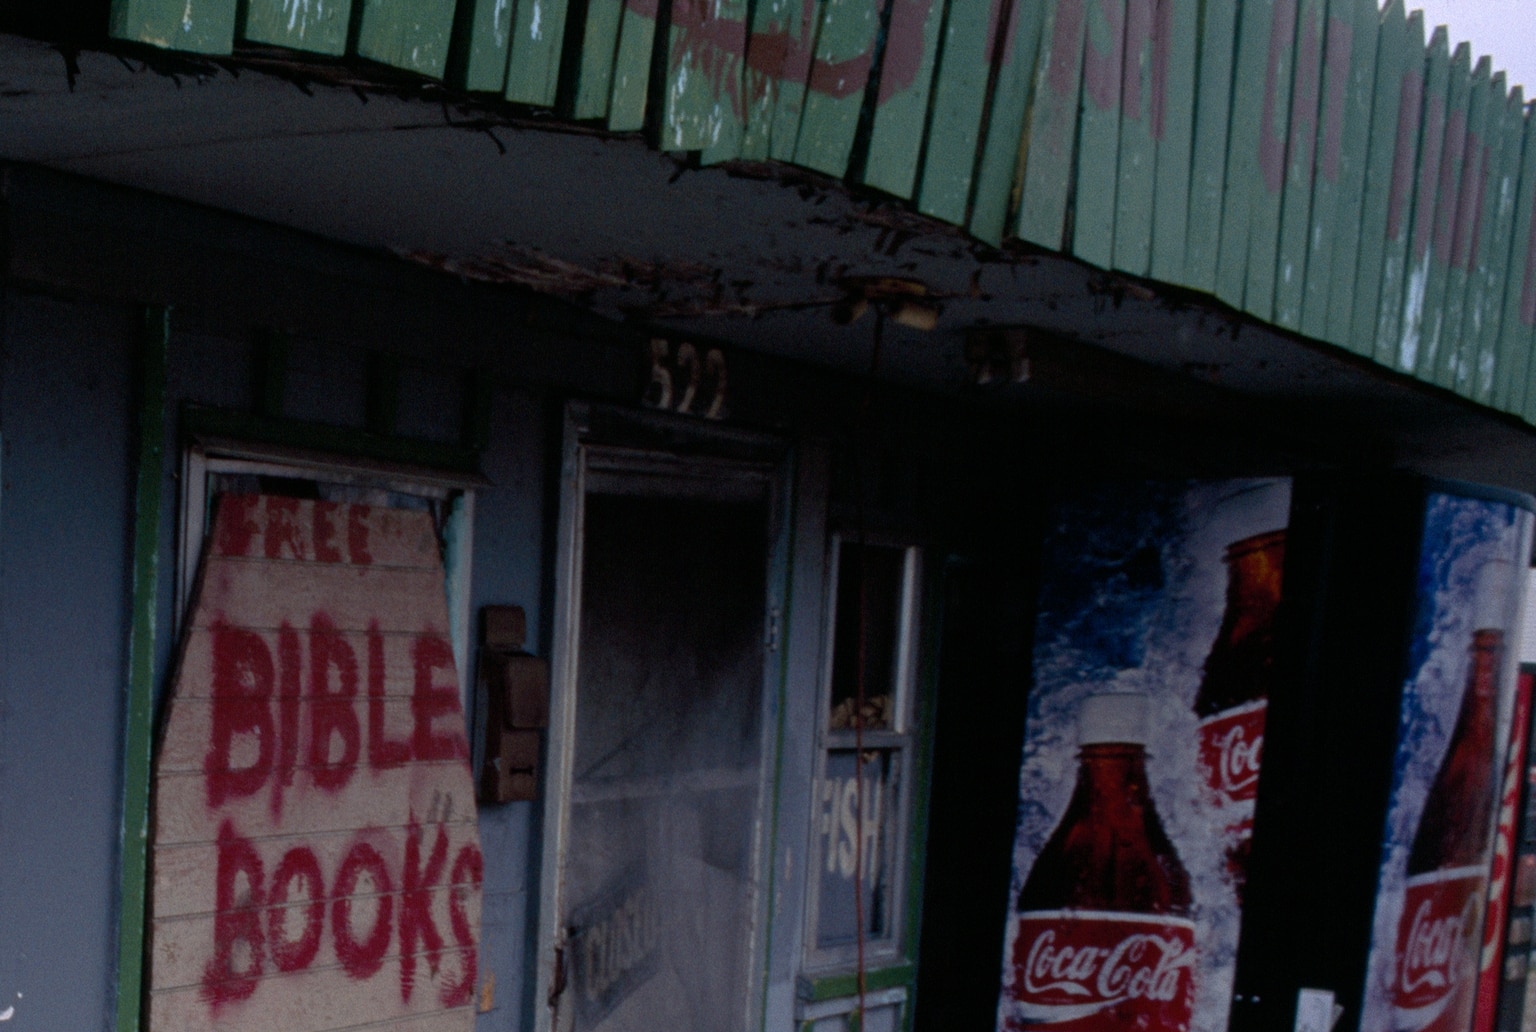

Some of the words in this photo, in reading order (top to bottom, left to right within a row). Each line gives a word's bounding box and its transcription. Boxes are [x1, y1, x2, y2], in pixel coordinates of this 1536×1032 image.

[216, 494, 374, 570] FREE
[205, 608, 466, 820] BIBLE
[811, 777, 883, 890] FISH
[200, 806, 484, 1018] BOOKS
[1025, 929, 1197, 1001] Coca-Cola
